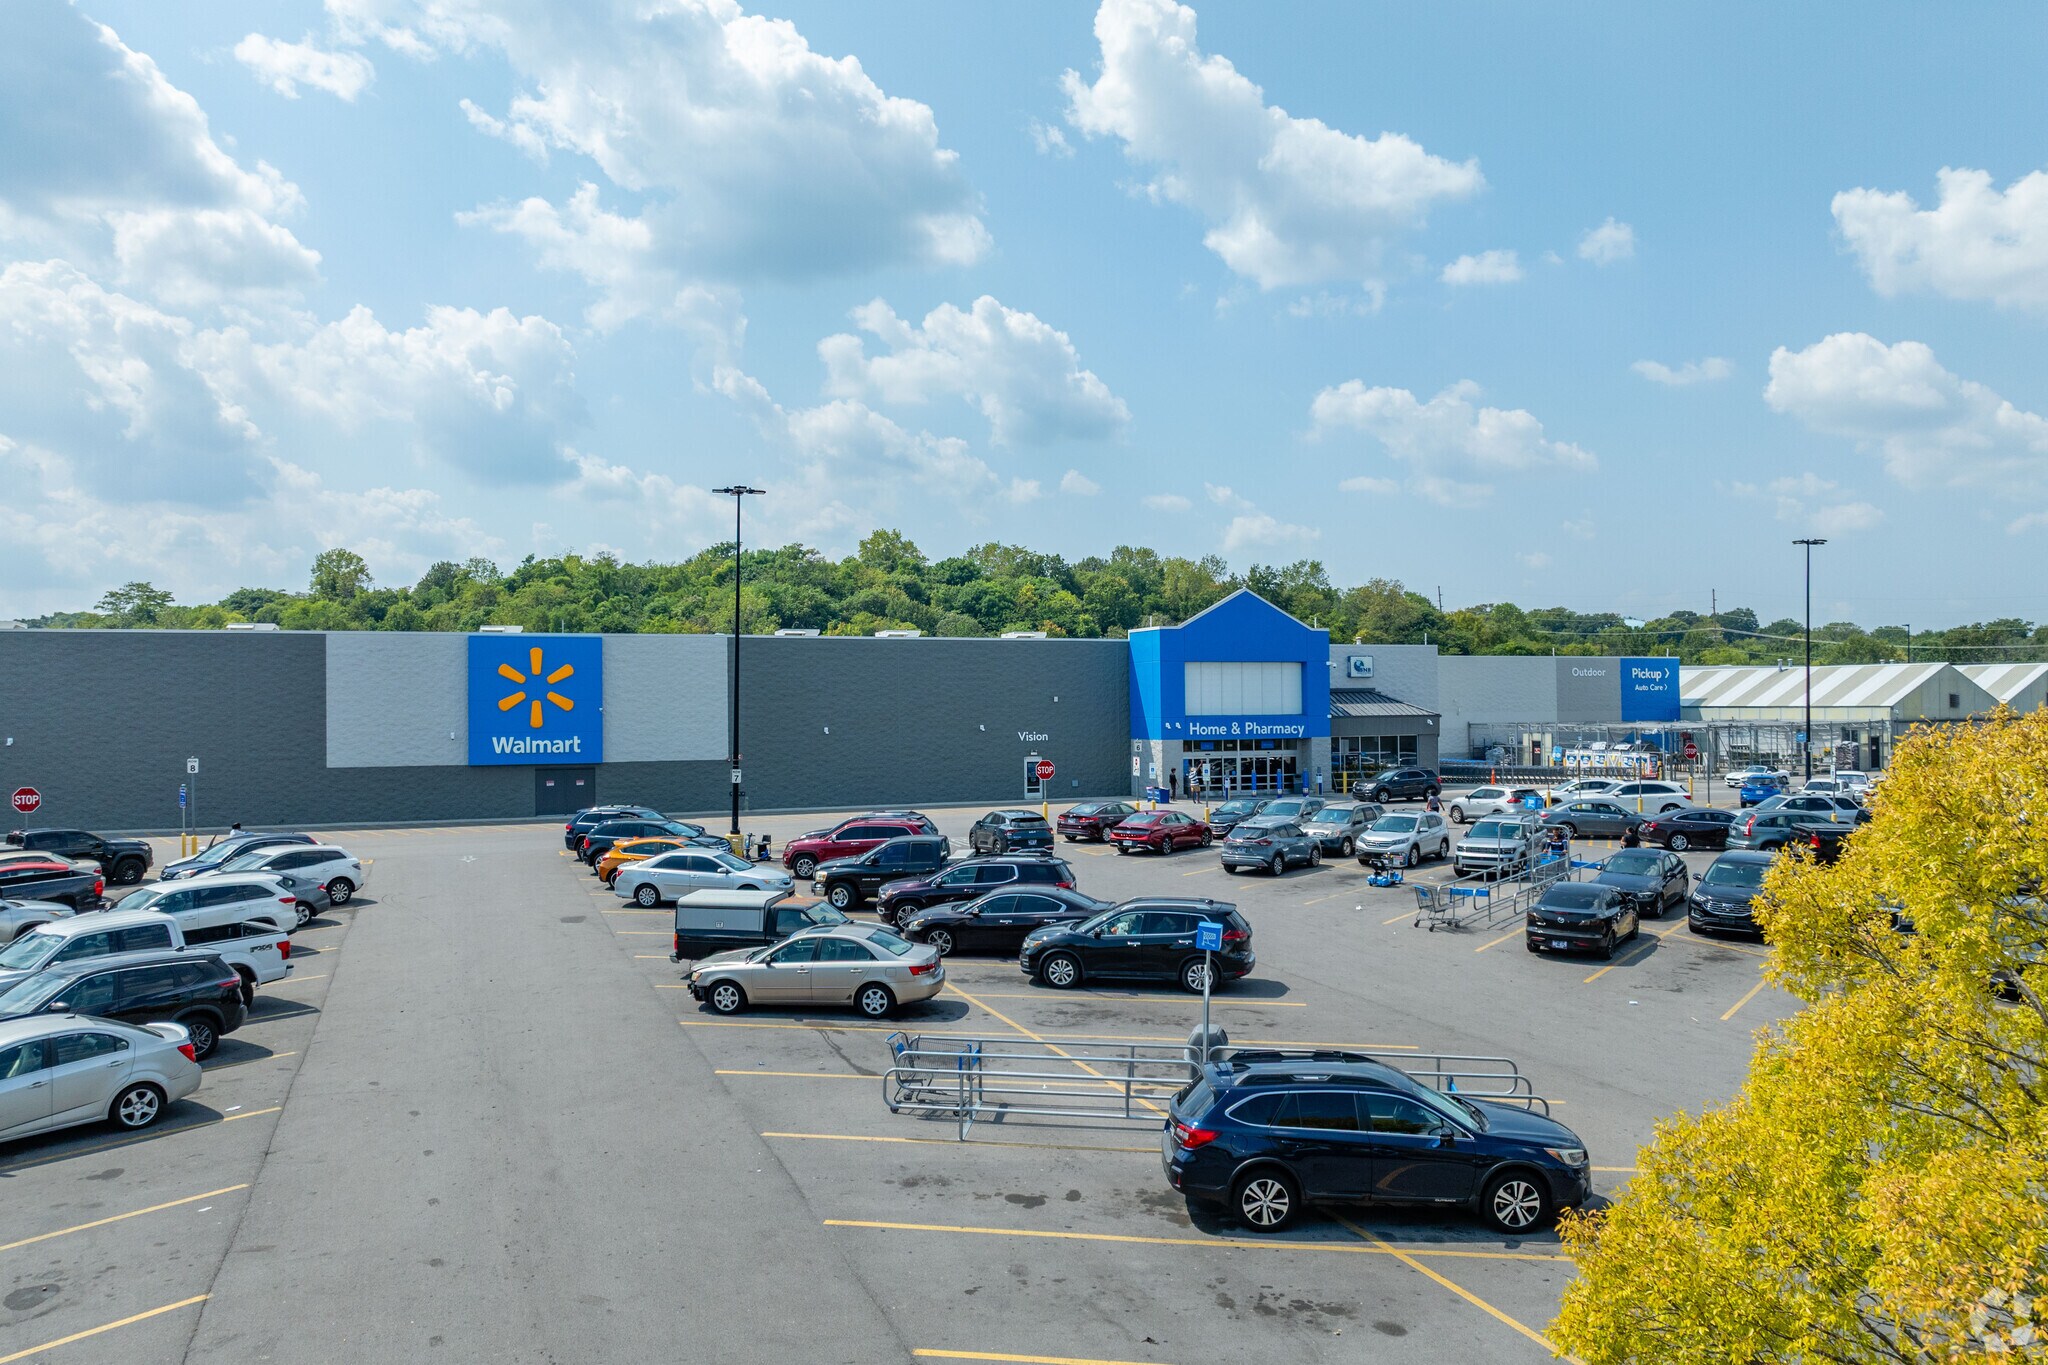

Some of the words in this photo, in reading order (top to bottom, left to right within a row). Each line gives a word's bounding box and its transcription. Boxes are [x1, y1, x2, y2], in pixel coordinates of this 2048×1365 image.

[1572, 667, 1606, 677] Outdoor
[1632, 668, 1662, 682] Pickup
[1189, 722, 1227, 735] Home
[1231, 722, 1241, 735] &
[1245, 722, 1305, 738] Pharmacy
[1018, 731, 1049, 741] Vision
[491, 735, 582, 754] Walmart
[190, 764, 196, 772] 8
[1037, 766, 1054, 774] STOP
[734, 774, 740, 782] 7
[14, 794, 40, 805] STOP
